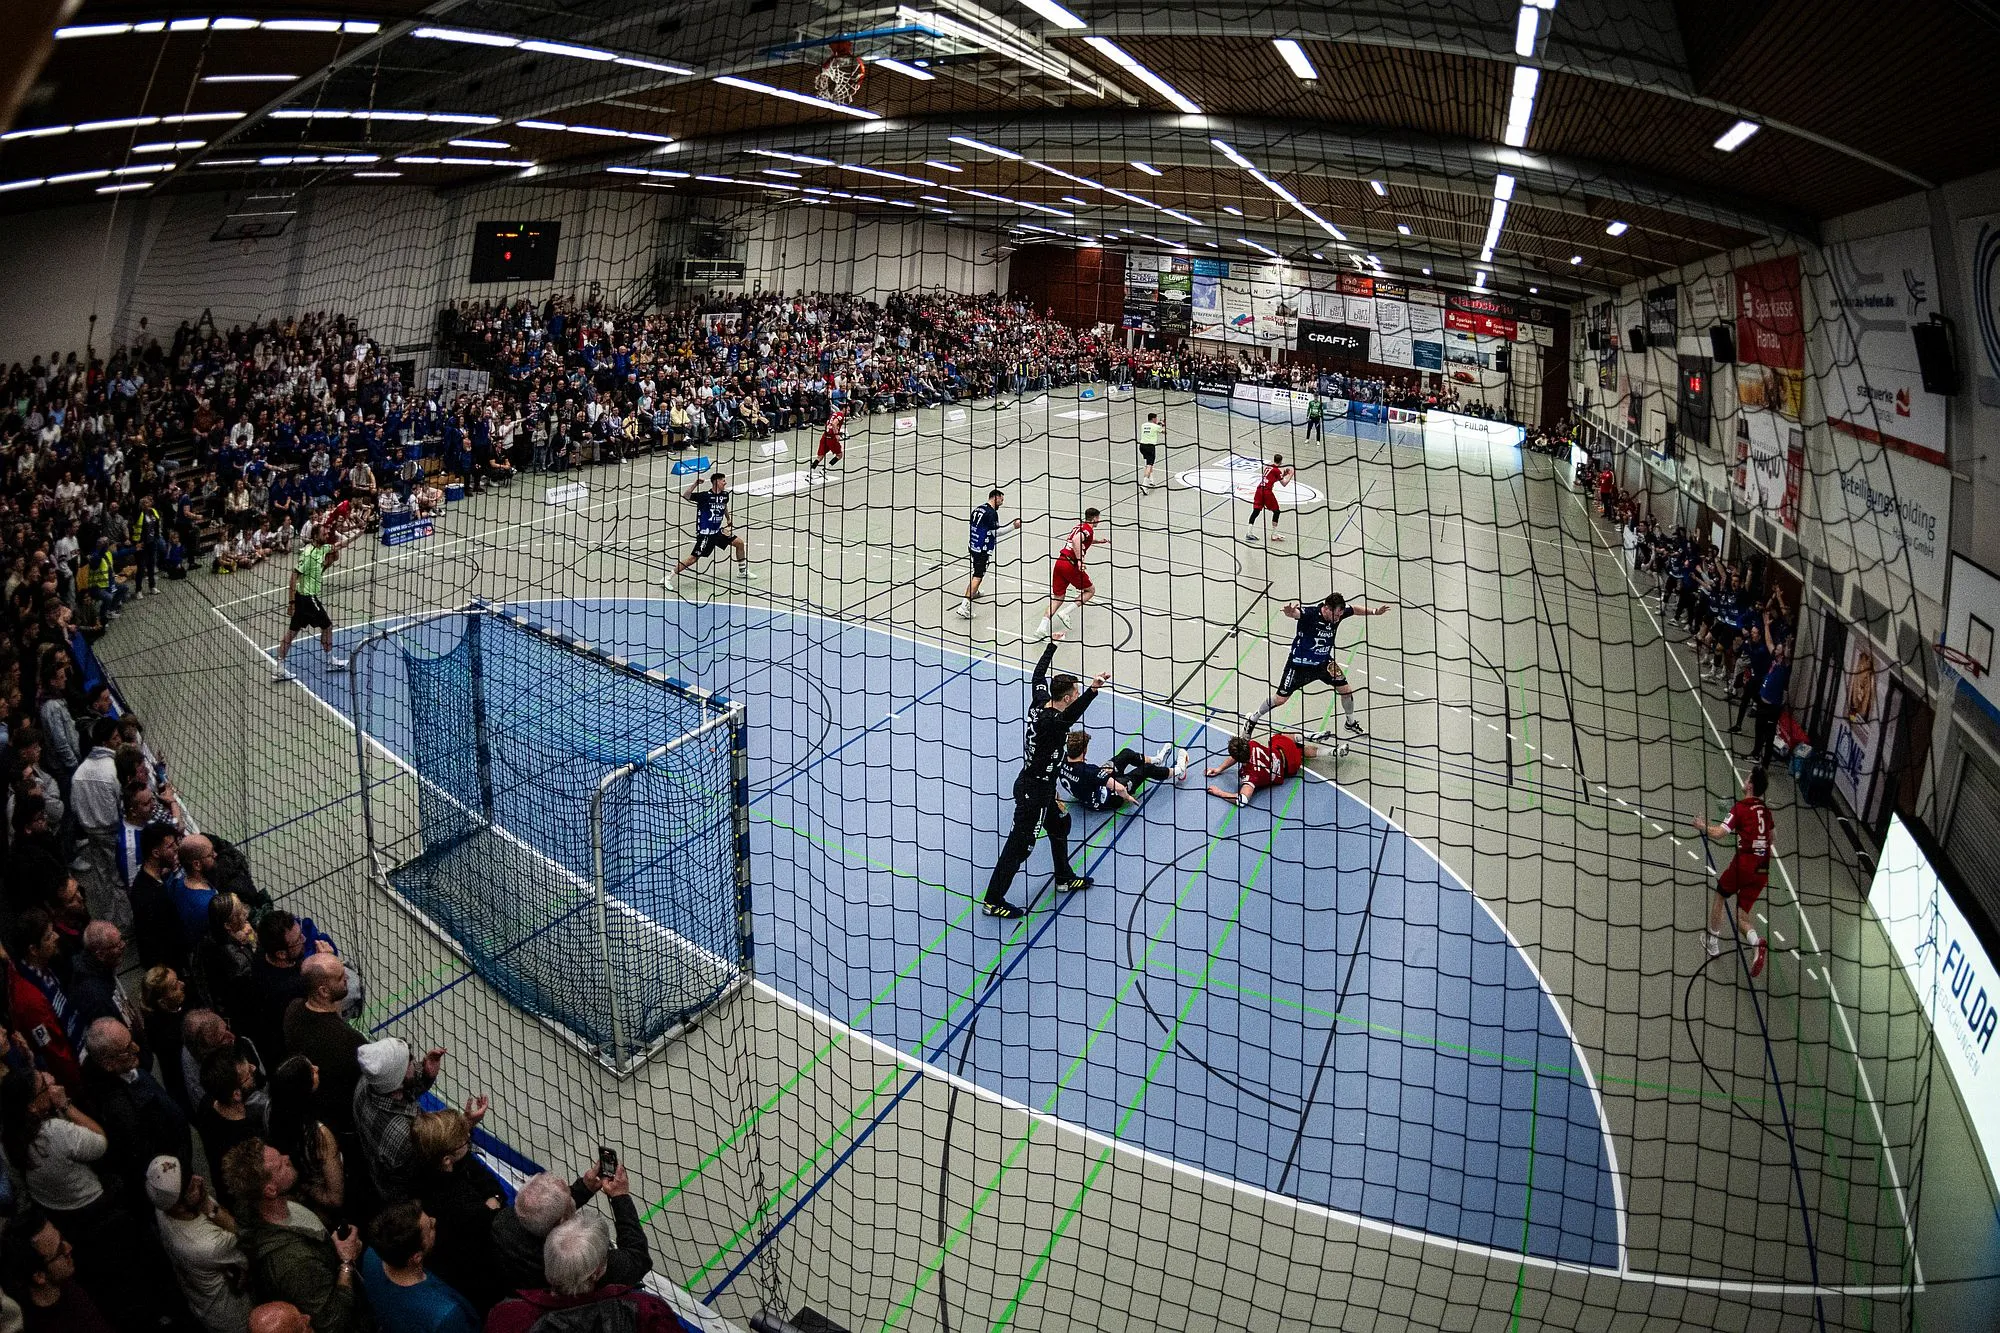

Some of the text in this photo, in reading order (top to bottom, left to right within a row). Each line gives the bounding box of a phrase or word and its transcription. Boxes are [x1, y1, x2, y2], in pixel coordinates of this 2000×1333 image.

[1308, 333, 1348, 346] CRAFT
[1757, 810, 1765, 834] 5
[1942, 939, 1998, 1055] FULDA
